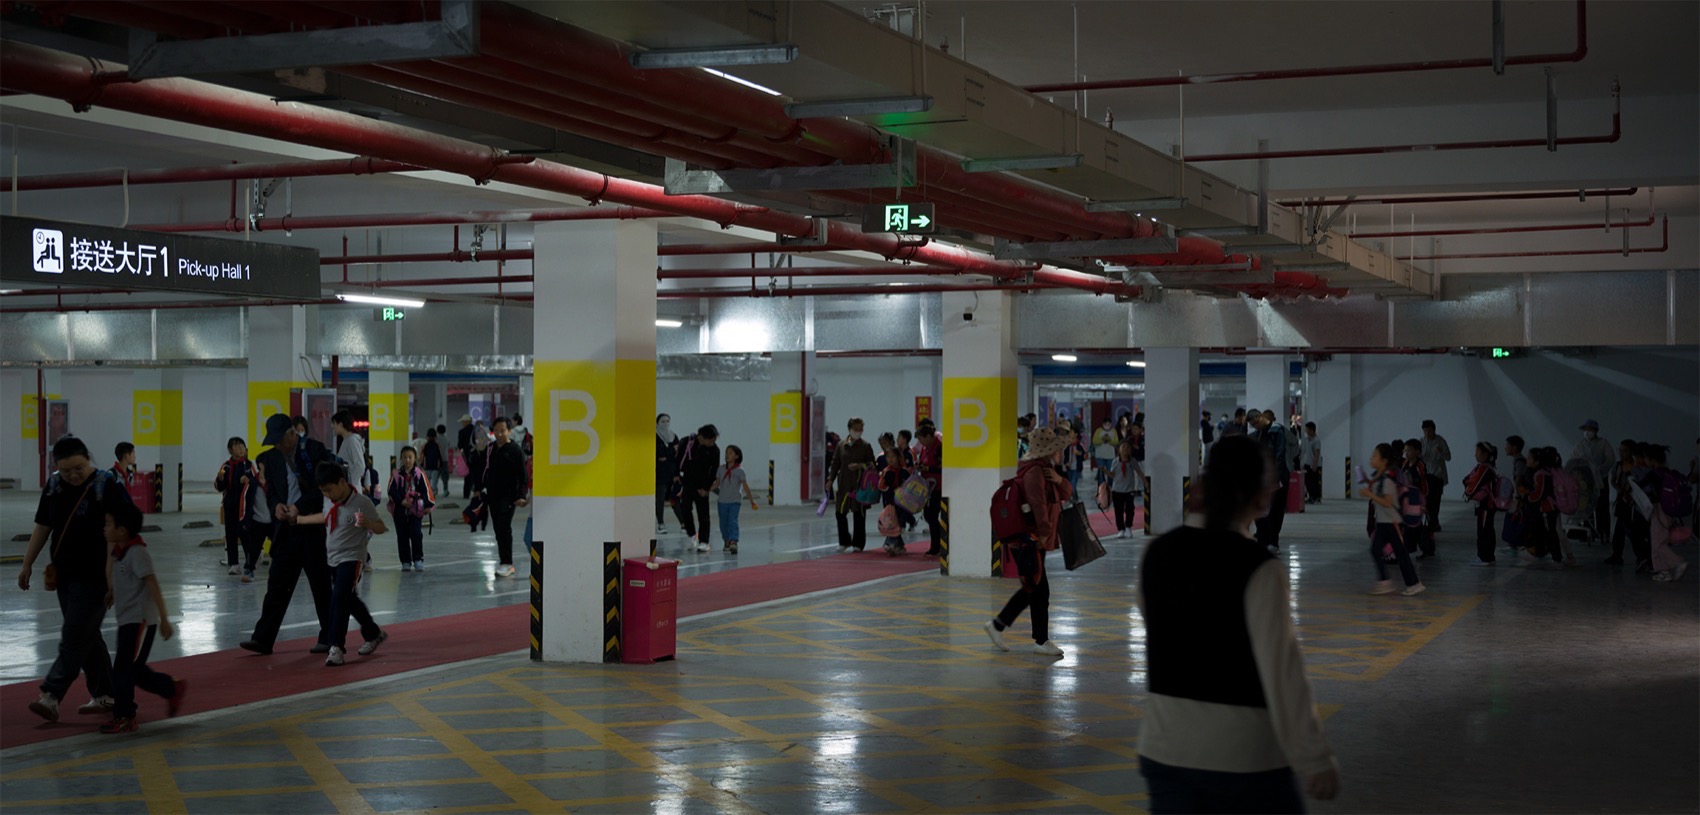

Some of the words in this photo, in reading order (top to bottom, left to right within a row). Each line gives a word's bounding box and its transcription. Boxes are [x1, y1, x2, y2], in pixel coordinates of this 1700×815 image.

[179, 258, 219, 282] Pick-up
[222, 263, 242, 280] Hall
[245, 264, 250, 281] 1
[23, 403, 39, 429] B
[138, 402, 157, 433] B
[373, 403, 391, 431] B
[550, 389, 600, 465] B
[776, 403, 797, 432] B
[953, 397, 989, 448] B
